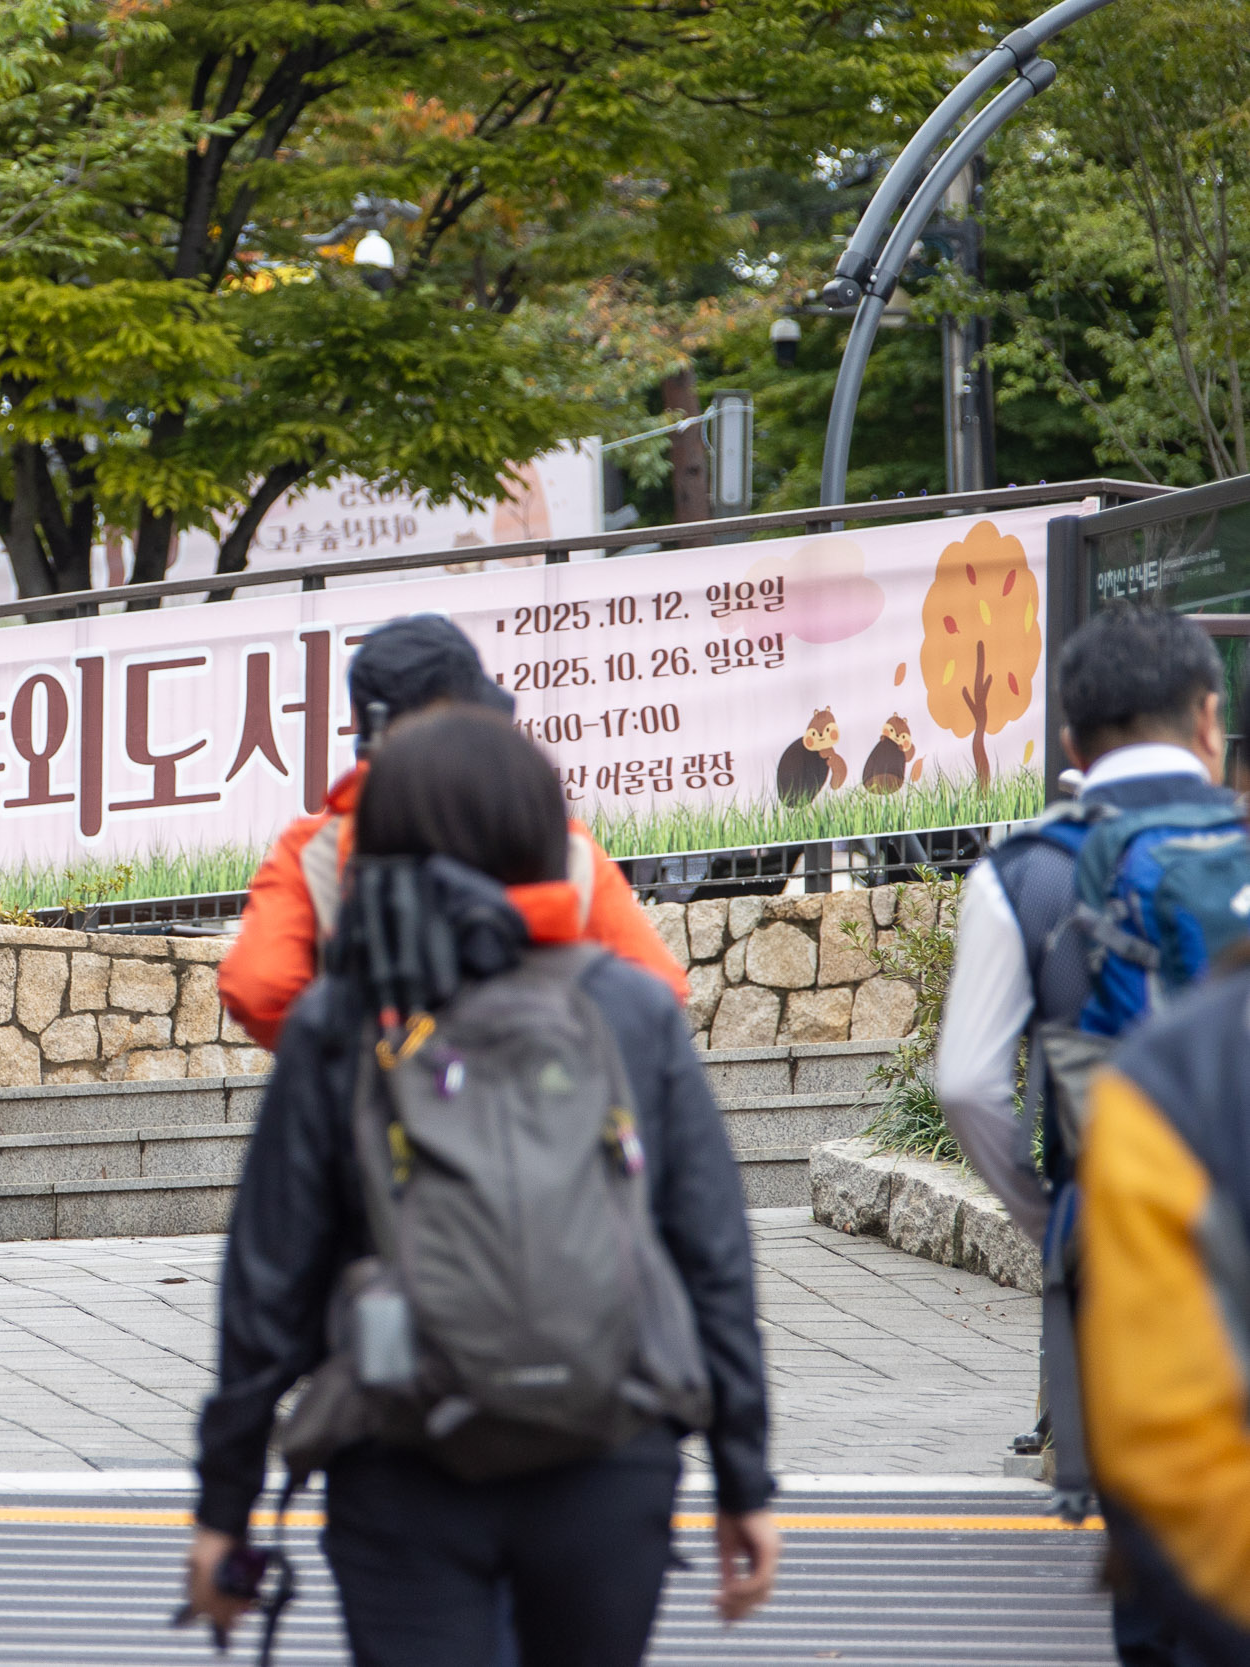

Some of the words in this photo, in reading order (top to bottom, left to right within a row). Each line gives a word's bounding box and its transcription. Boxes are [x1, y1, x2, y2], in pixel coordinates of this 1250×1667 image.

[705, 576, 785, 618] 일요일
[705, 633, 785, 675] 일요일
[596, 757, 673, 796] 어울림
[680, 751, 735, 790] 광장
